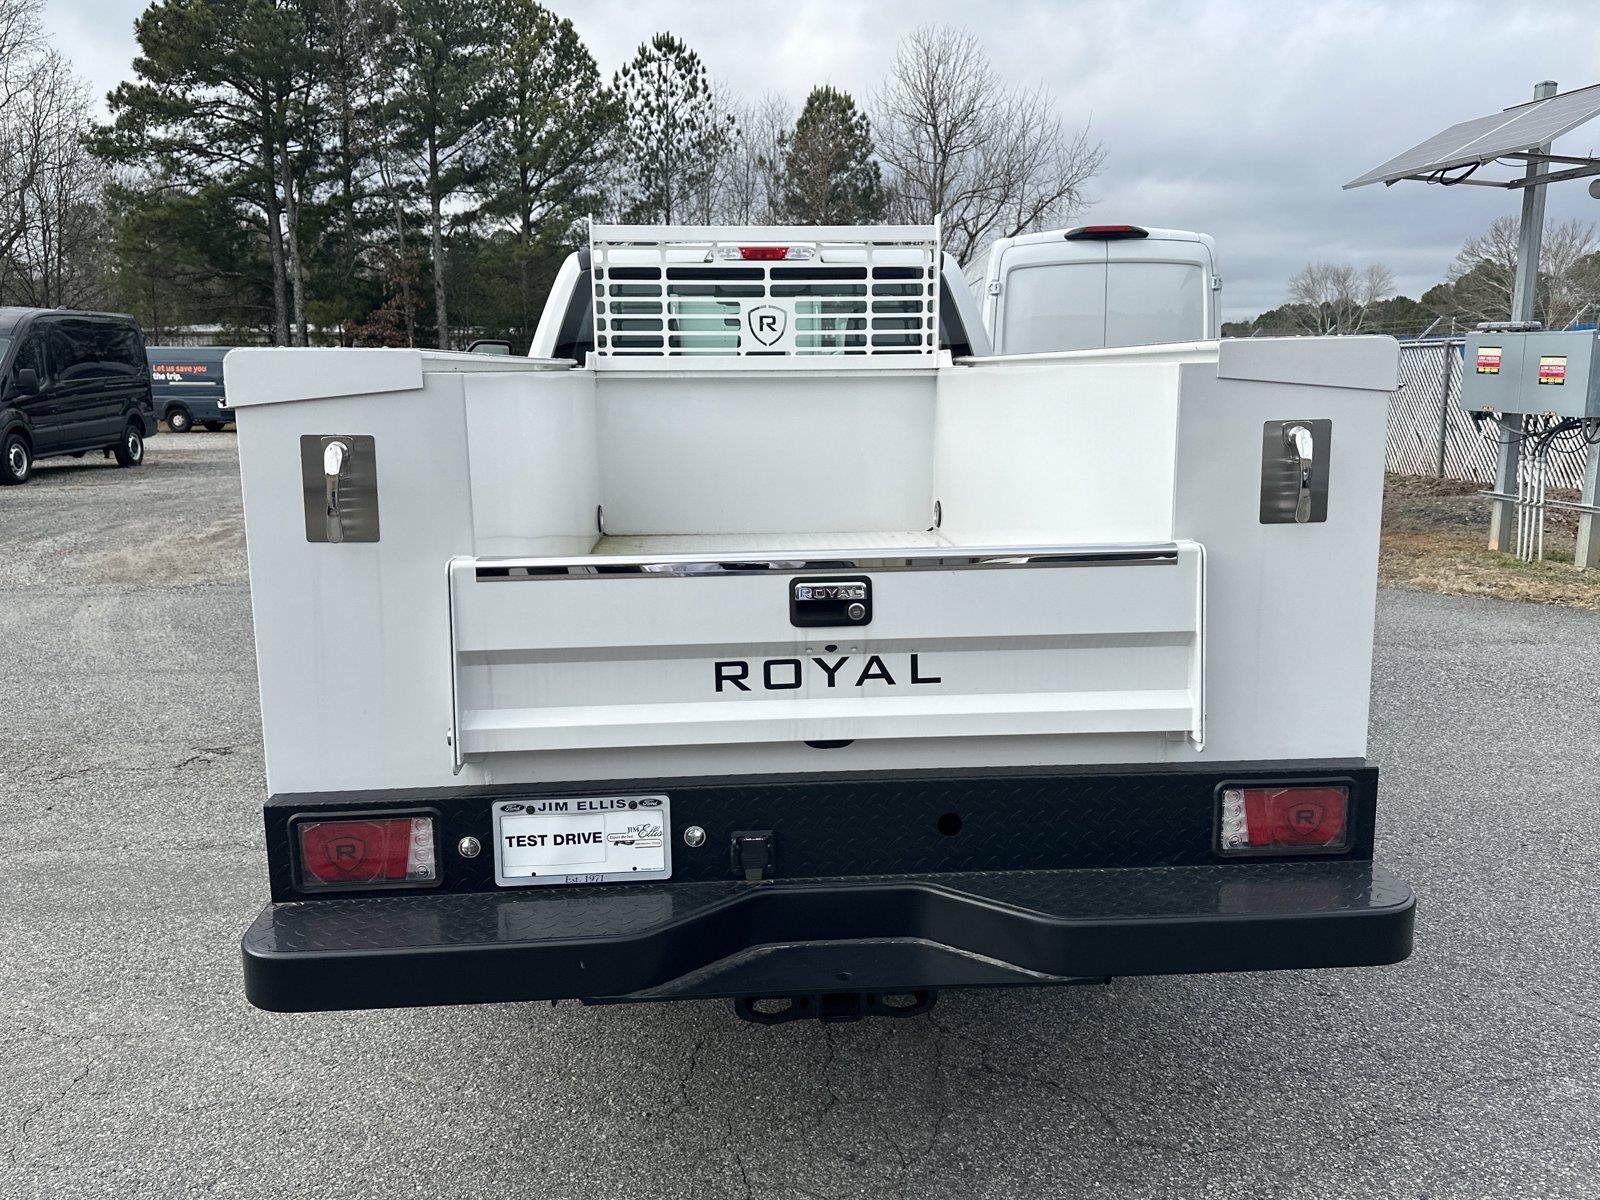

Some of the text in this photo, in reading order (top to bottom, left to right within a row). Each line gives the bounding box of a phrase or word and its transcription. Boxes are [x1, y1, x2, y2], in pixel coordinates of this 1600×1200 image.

[759, 315, 777, 332] R
[152, 364, 165, 372] Let
[193, 365, 207, 374] you
[152, 372, 183, 382] the trip.
[799, 586, 865, 599] ROYAL
[714, 653, 942, 692] ROYAL
[537, 799, 627, 812] JIM ELLIS
[1296, 810, 1314, 824] R
[505, 831, 603, 848] TEST DRIVE
[335, 845, 356, 860] R
[585, 874, 604, 882] 1971
